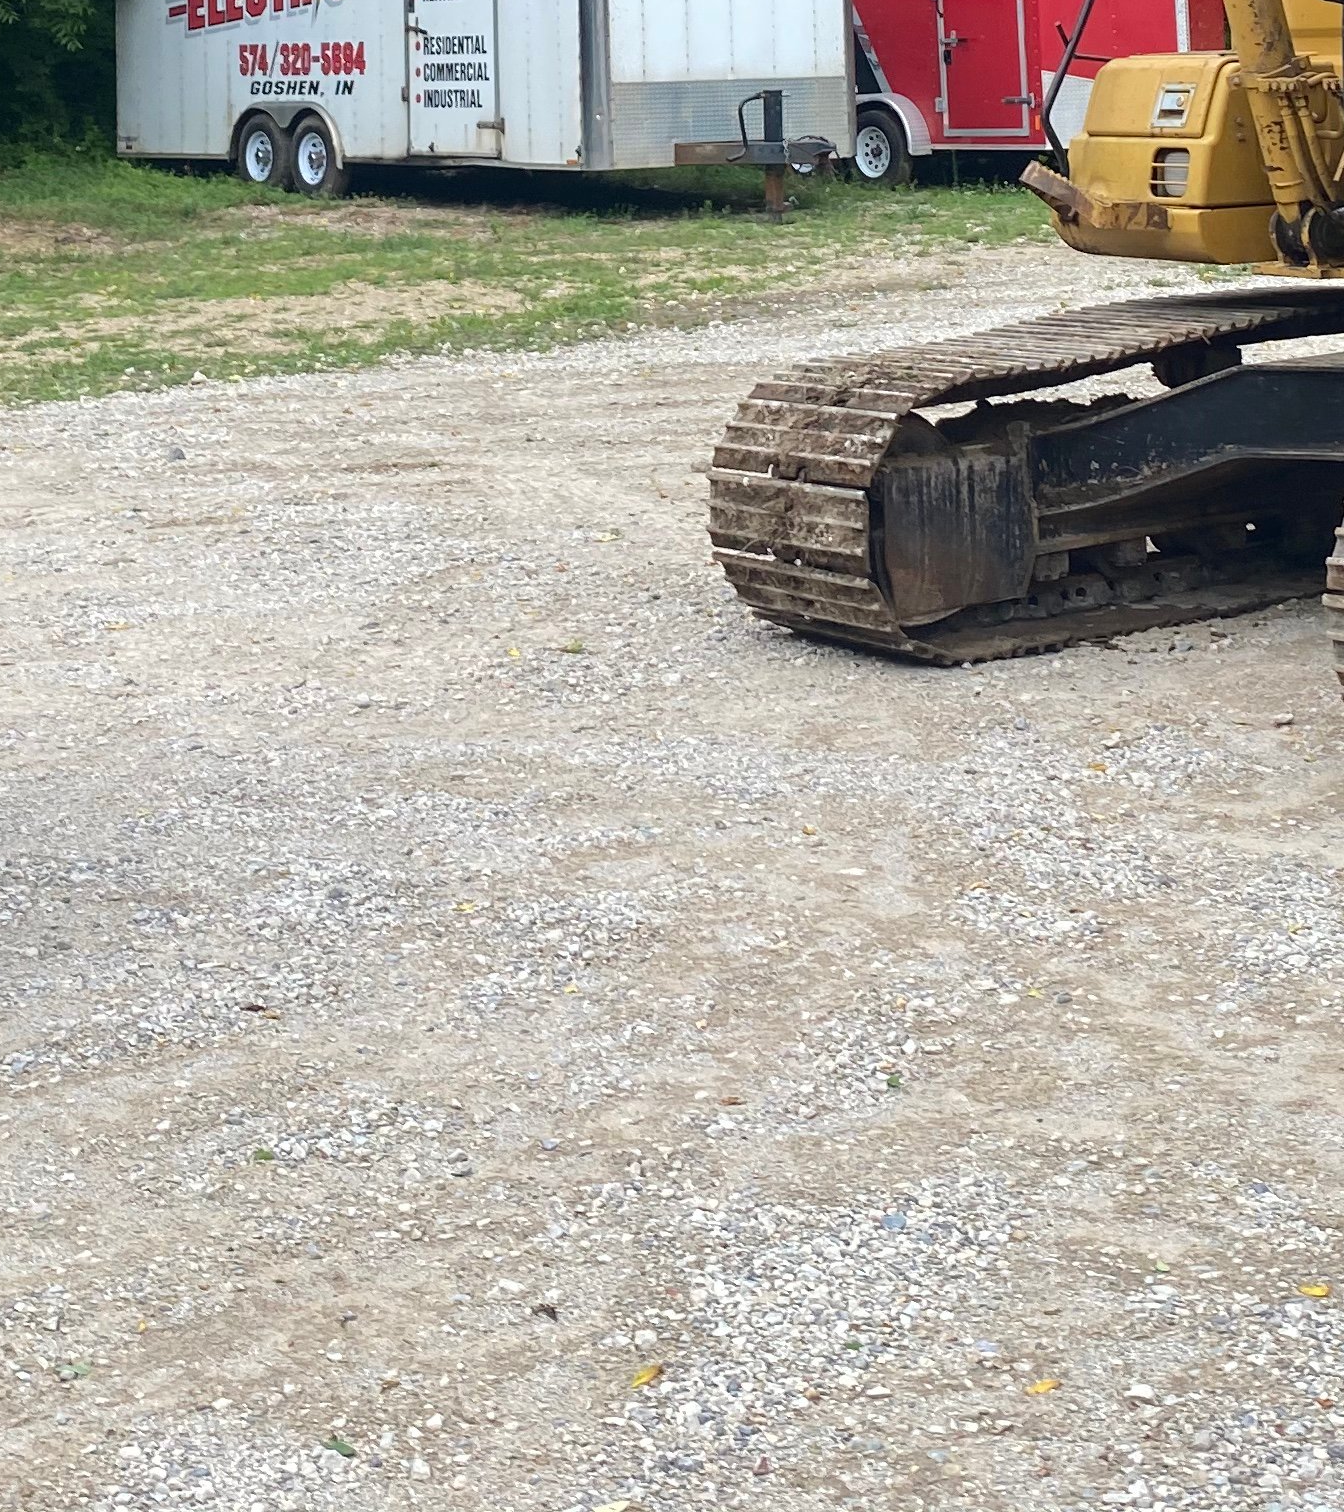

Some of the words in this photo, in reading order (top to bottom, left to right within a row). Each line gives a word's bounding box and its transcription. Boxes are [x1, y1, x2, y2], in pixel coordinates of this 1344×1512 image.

[423, 35, 487, 56] RESIDENTIAL
[423, 62, 490, 82] COMMERCIAL
[250, 80, 324, 97] GOSHEN,
[334, 80, 355, 96] IN
[423, 89, 483, 108] INDUSTRIAL
